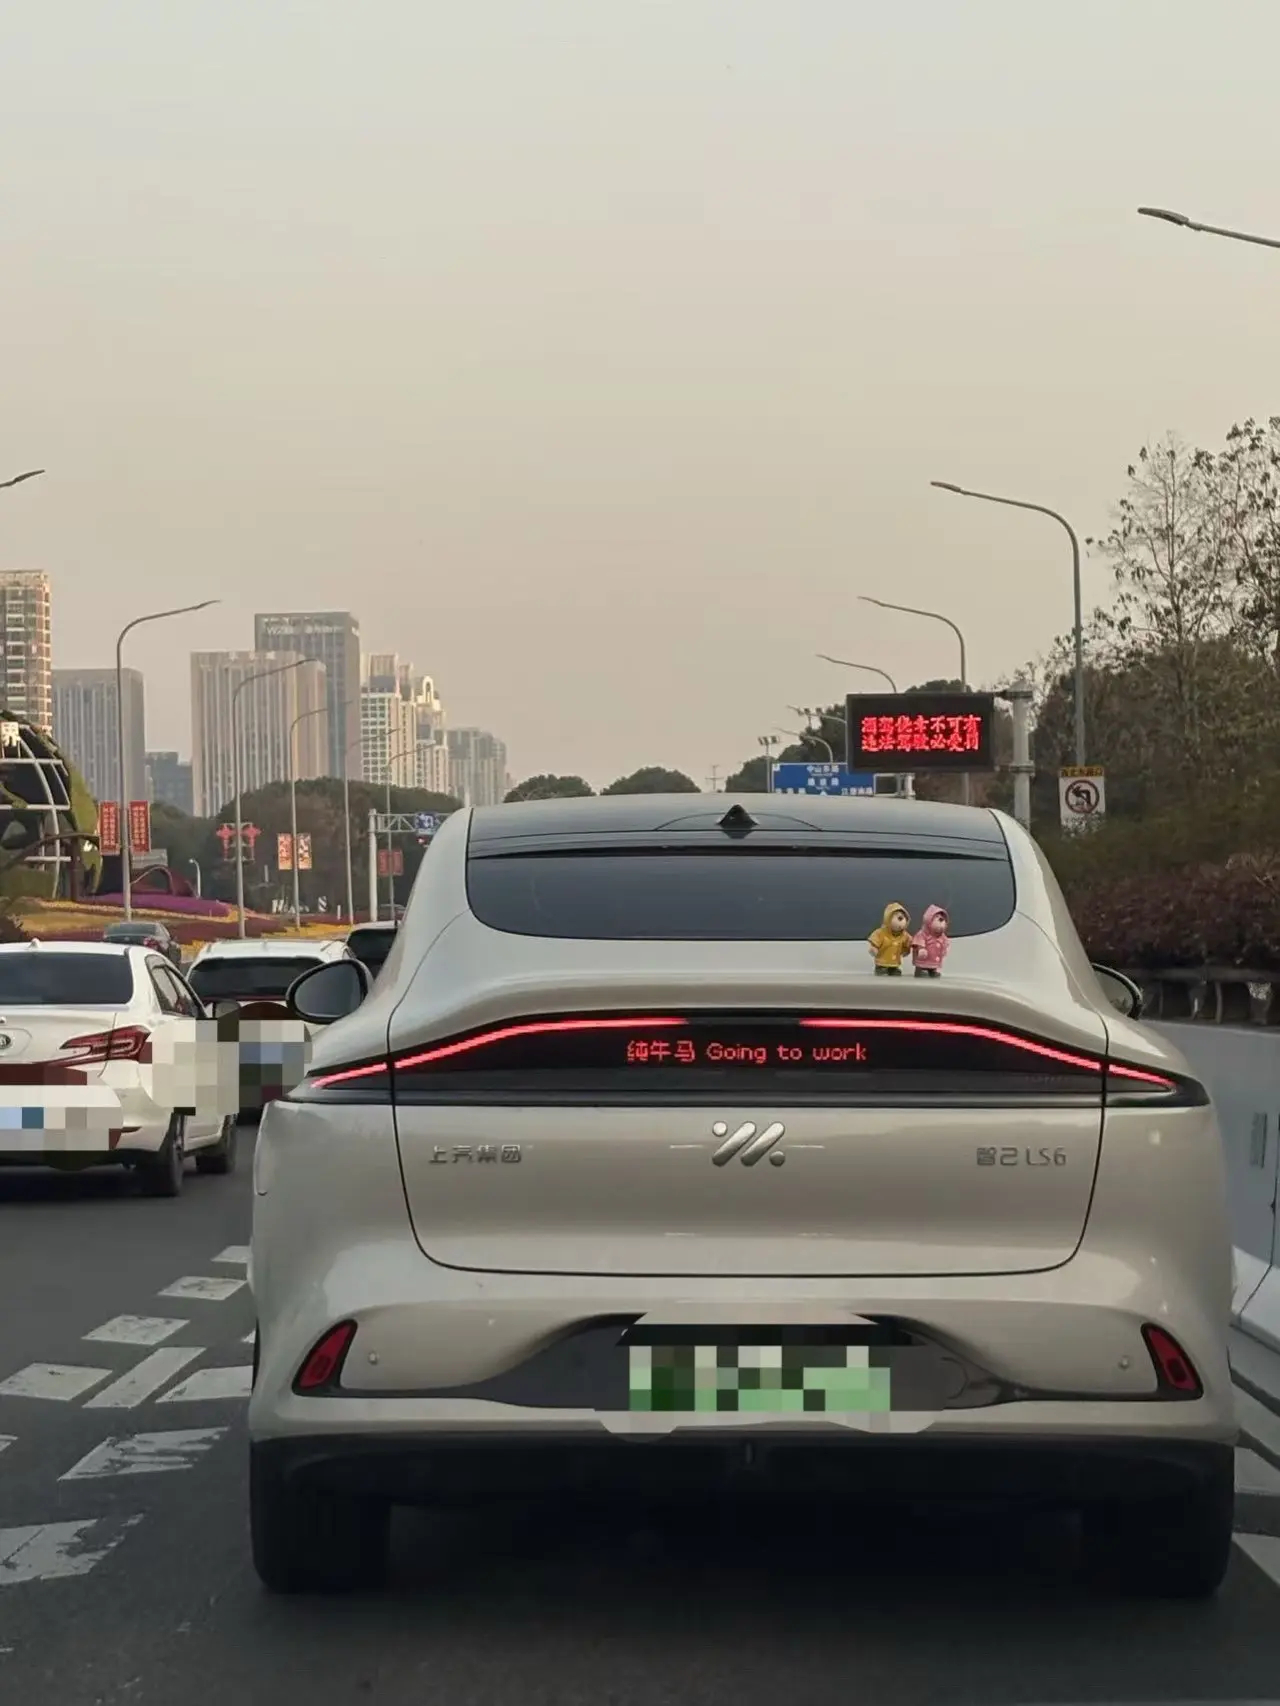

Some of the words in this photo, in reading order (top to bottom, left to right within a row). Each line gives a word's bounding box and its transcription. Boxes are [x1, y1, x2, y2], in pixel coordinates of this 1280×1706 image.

[627, 1040, 696, 1063] 纯牛马
[706, 1042, 767, 1064] Going
[777, 1044, 803, 1061] to
[812, 1042, 867, 1061] work
[428, 1144, 522, 1164] 上汽集团
[1025, 1146, 1067, 1166] LS6
